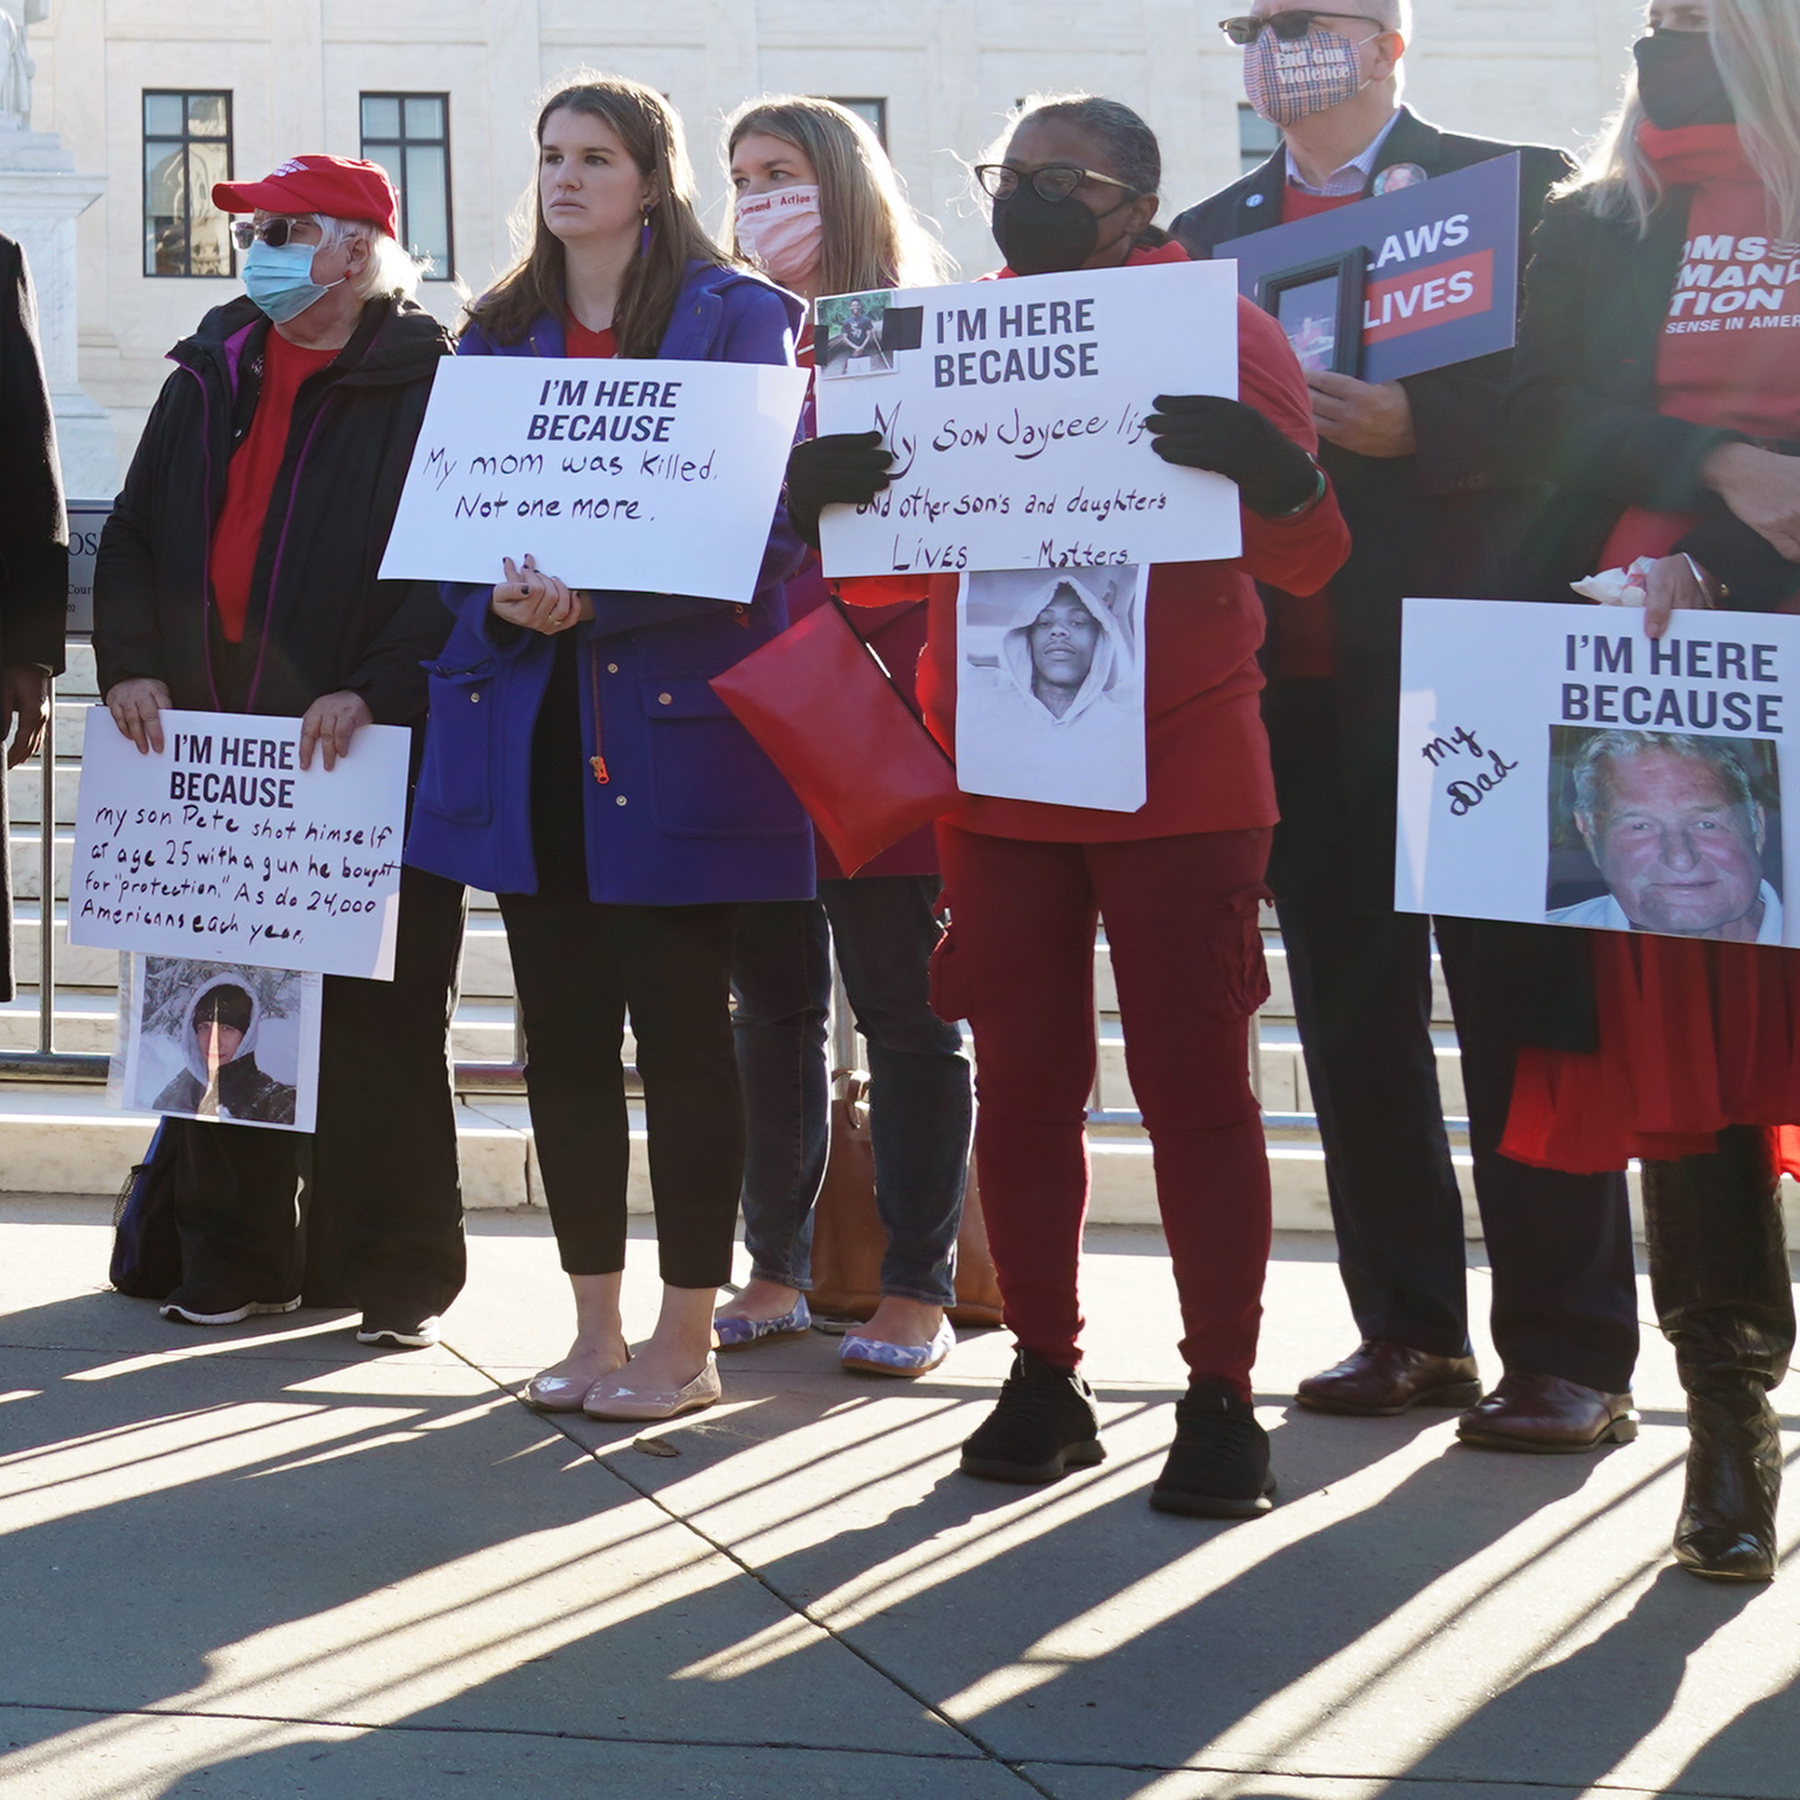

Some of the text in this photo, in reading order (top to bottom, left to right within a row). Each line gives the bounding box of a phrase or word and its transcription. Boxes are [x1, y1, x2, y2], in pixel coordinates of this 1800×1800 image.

[1366, 213, 1469, 271] AWS
[936, 298, 1095, 344] I'M HERE
[1363, 270, 1474, 330] LIVES
[1668, 288, 1785, 317] TION
[1665, 314, 1800, 334] SENSE IN AMER
[934, 342, 1100, 388] BECAUSE
[538, 380, 683, 408] I'M HERE
[527, 414, 675, 443] BECAUSE
[873, 400, 1151, 481] My Jaycee lif
[423, 447, 458, 491] My
[469, 452, 544, 476] mom
[561, 454, 624, 477] was
[454, 492, 508, 520] Not
[517, 499, 561, 518] one
[899, 486, 951, 523] other
[1025, 493, 1058, 515] and
[1565, 634, 1779, 683] I'M HERE
[1561, 683, 1783, 734] BECAUSE
[174, 734, 296, 770] I'M HERE
[170, 772, 296, 809] BECAUSE
[1446, 749, 1518, 817] Dad
[135, 807, 172, 825] son
[183, 805, 240, 833] Pete
[251, 819, 296, 840] shot
[304, 822, 393, 849] himself
[117, 849, 156, 874] age
[166, 840, 192, 866] 25
[263, 857, 299, 881] gun
[308, 855, 331, 878] he
[85, 870, 110, 891] for
[276, 887, 298, 907] do
[306, 891, 376, 916] 24,000
[193, 911, 239, 934] each
